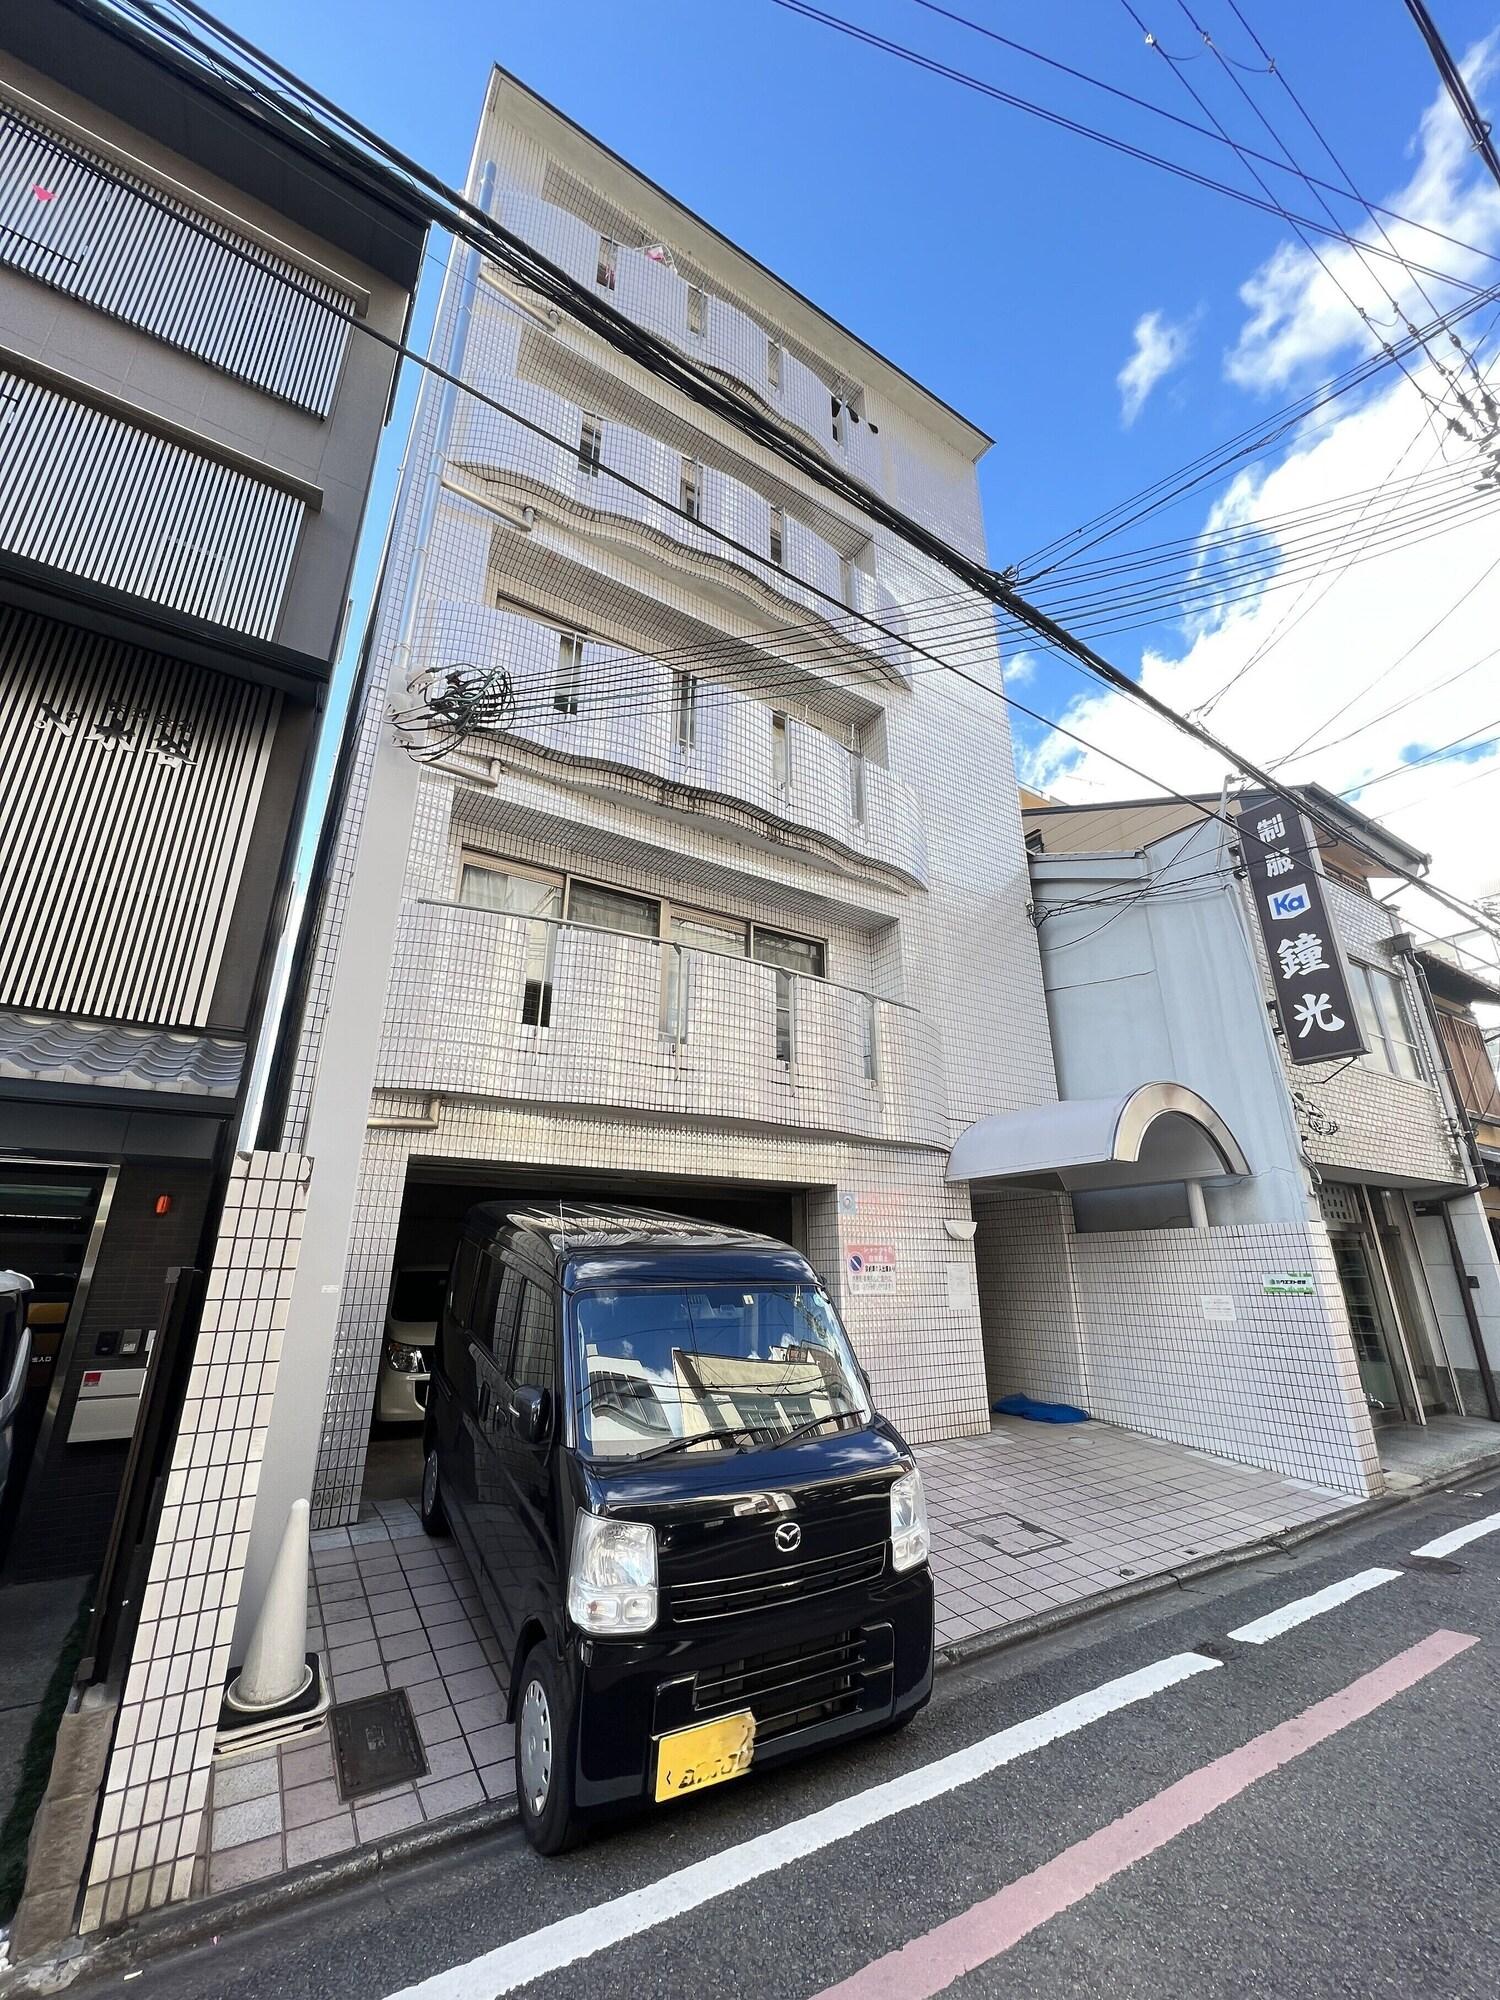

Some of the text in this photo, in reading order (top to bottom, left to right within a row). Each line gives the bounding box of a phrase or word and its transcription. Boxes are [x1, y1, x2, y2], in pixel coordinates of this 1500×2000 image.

[1256, 813, 1295, 878] 制服
[1273, 892, 1305, 917] Ka
[1276, 932, 1346, 1039] 鐘光
